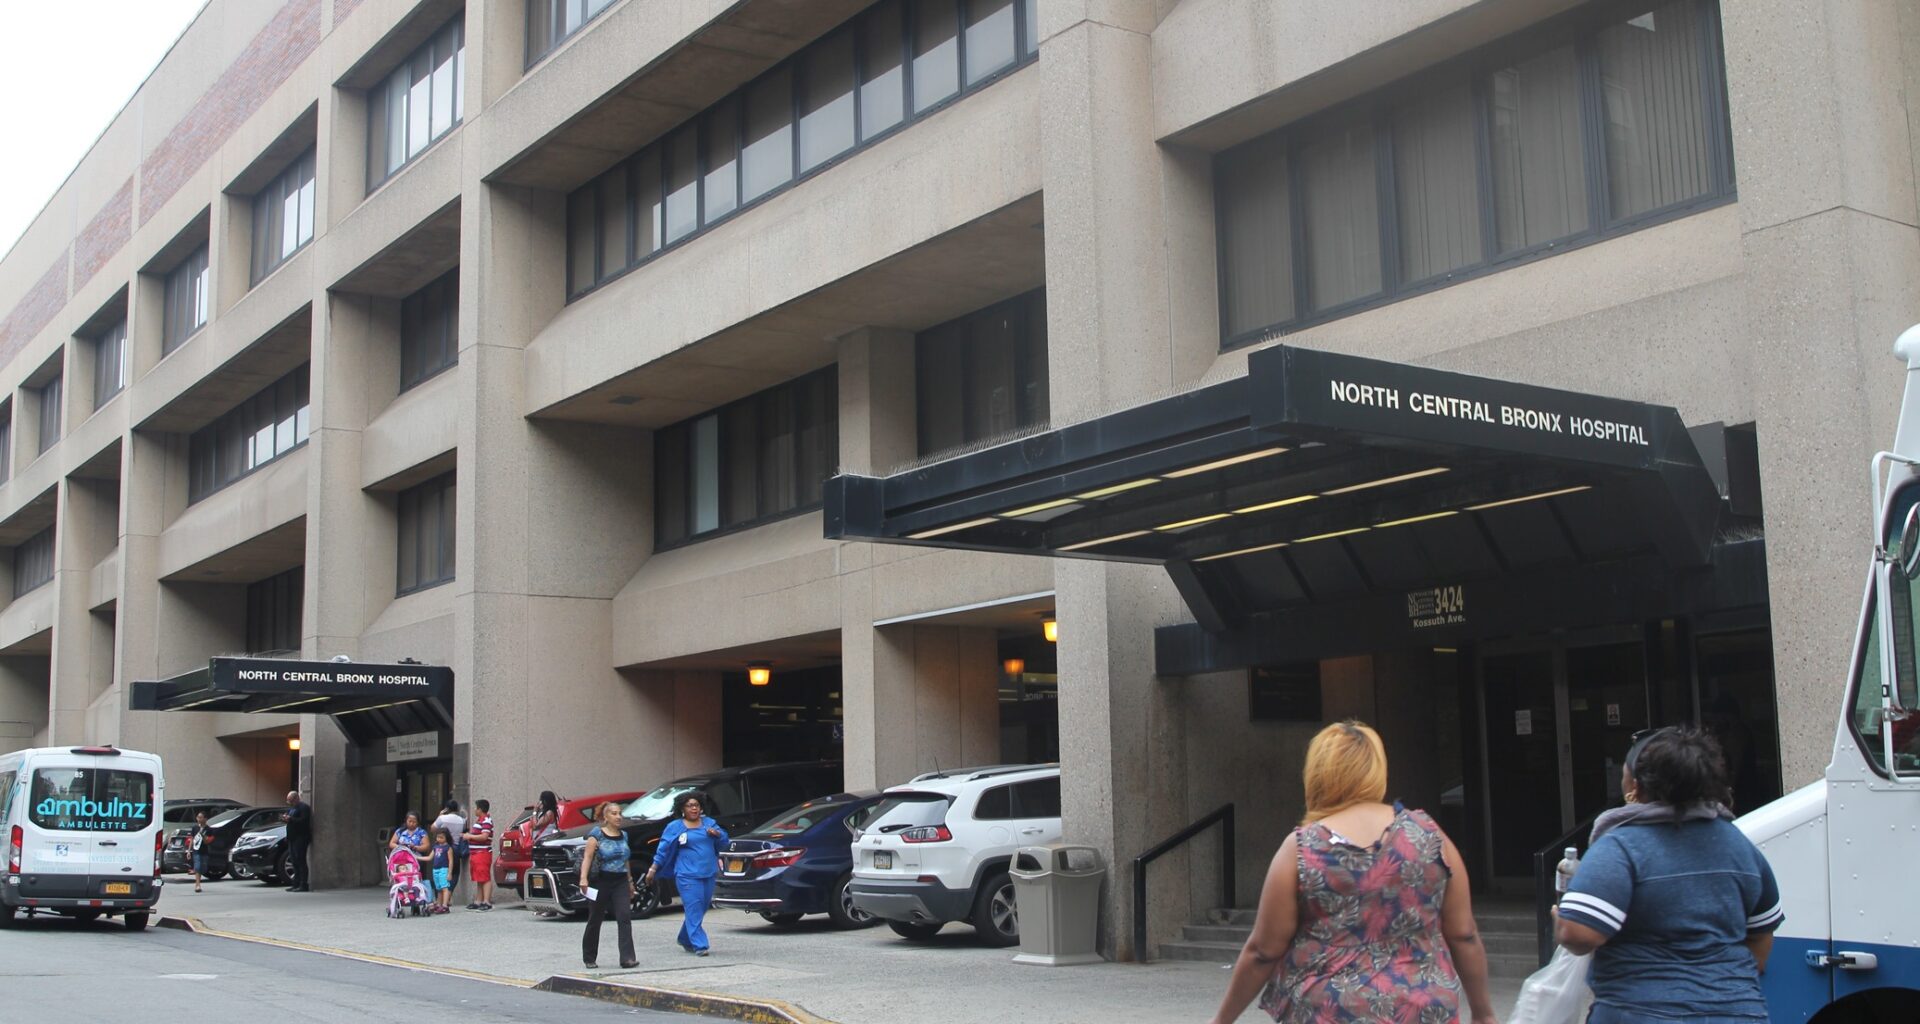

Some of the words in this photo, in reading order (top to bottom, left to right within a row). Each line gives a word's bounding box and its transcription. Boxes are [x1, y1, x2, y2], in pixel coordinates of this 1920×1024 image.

[1330, 380, 1400, 409] NORTH
[1409, 392, 1495, 423] CENTRAL
[1501, 406, 1562, 433] BRONX
[1569, 416, 1649, 445] HOSPITAL
[1434, 585, 1464, 615] 3424
[1413, 615, 1445, 628] Kossuth
[1447, 614, 1466, 624] Ave.
[238, 670, 277, 681] NORTH
[282, 672, 332, 683] CENTRAL
[336, 674, 374, 684] BRONX
[378, 675, 430, 686] HOSPITAL
[36, 795, 147, 819] ambulnz
[58, 820, 128, 830] AMBULETTE
